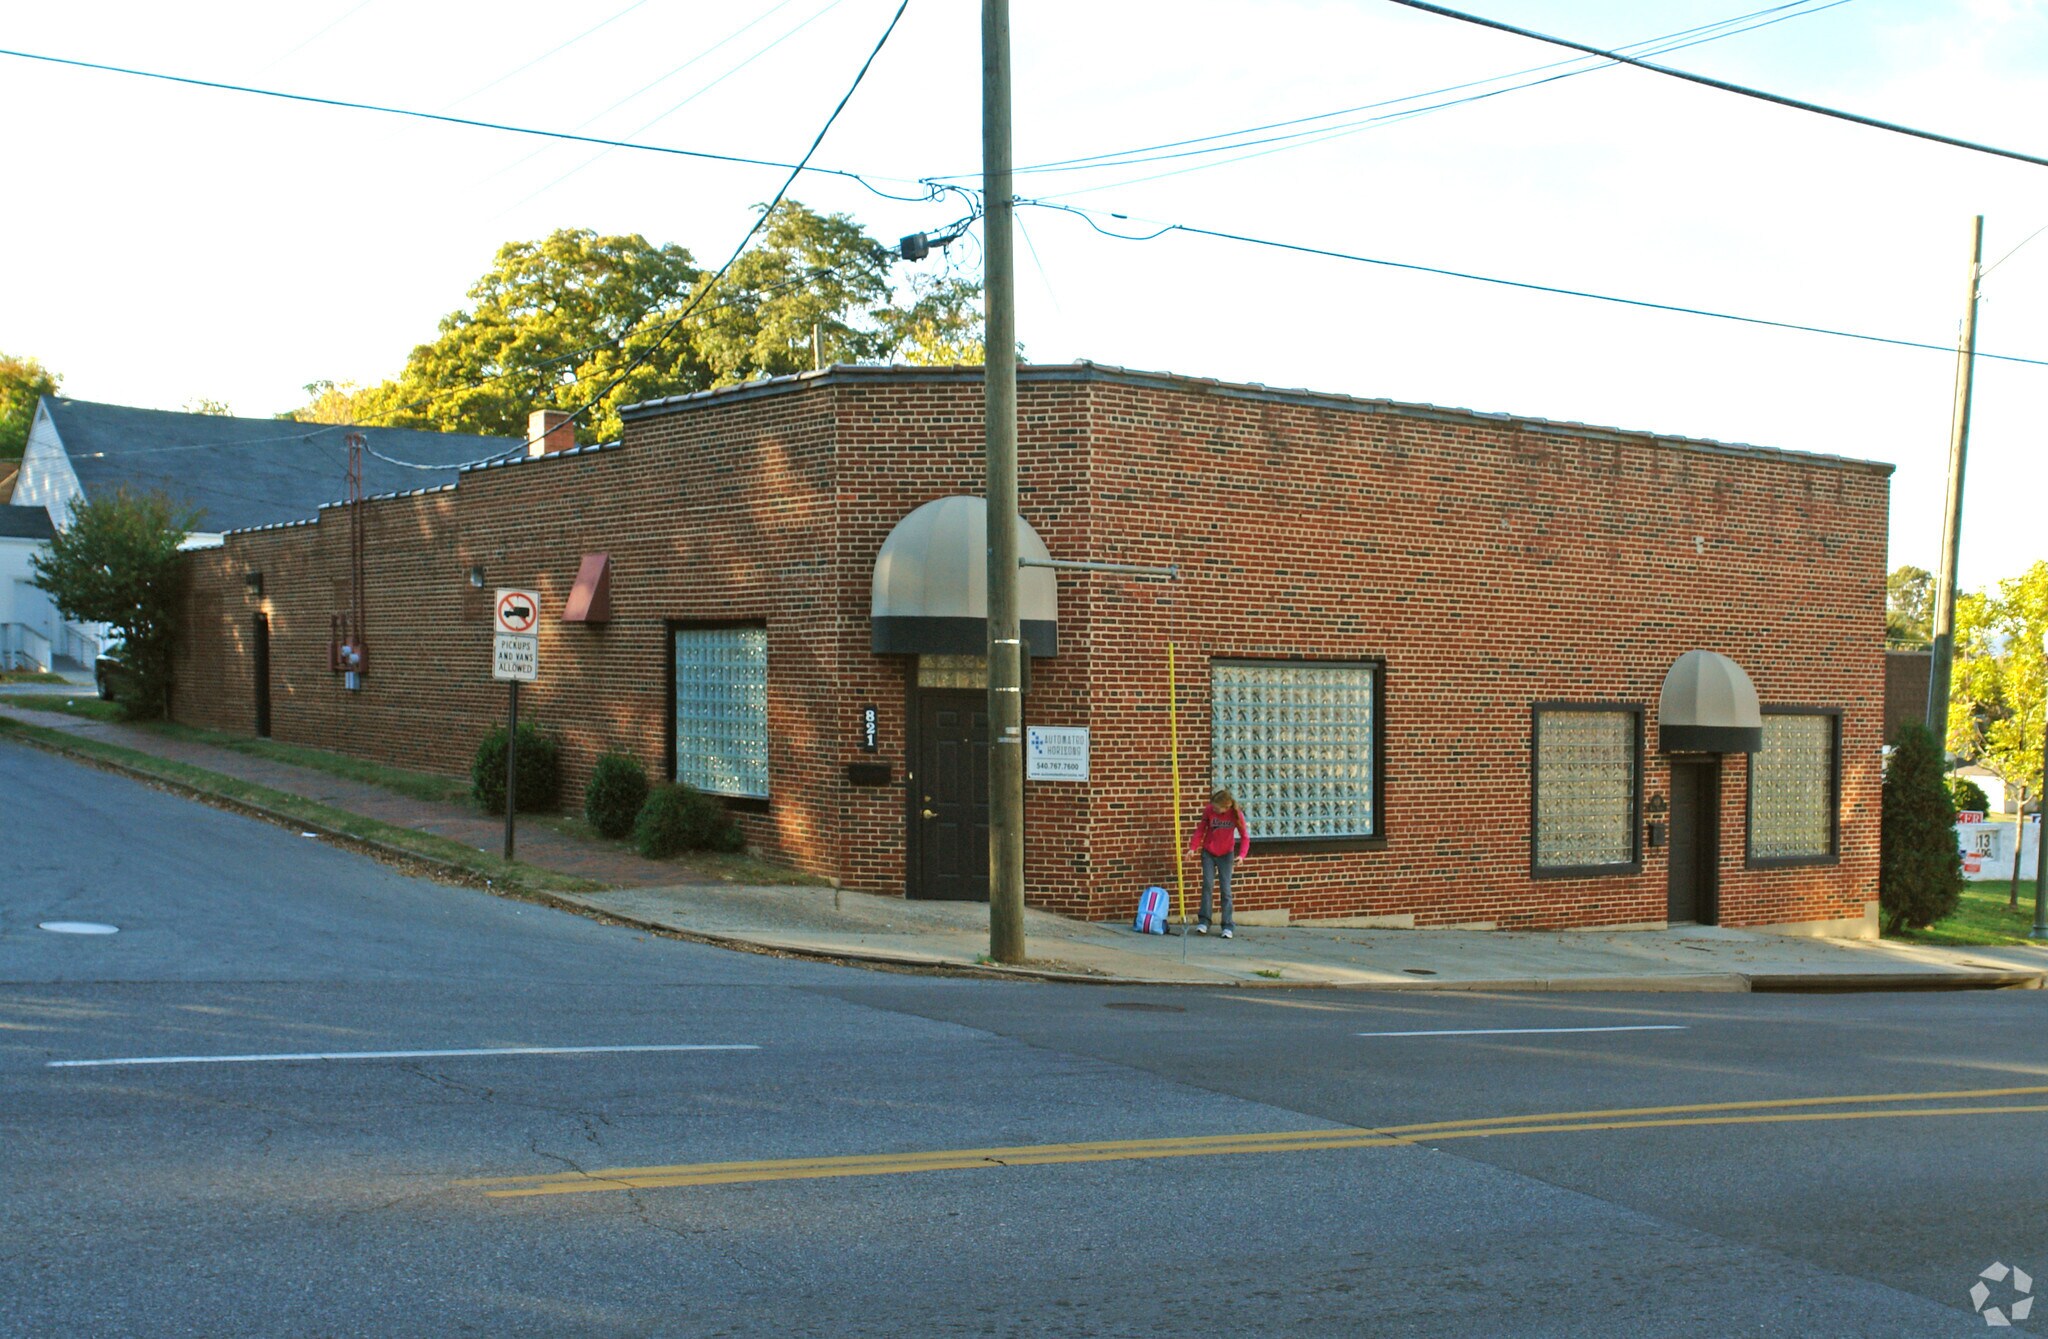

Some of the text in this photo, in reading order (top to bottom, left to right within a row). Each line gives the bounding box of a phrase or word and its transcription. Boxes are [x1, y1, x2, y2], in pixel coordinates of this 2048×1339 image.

[501, 640, 531, 651] PICKUPS
[498, 651, 534, 662] AND VANS
[498, 663, 533, 674] ALLOWED
[865, 709, 876, 746] 821
[1036, 762, 1080, 771] 540.767.7600
